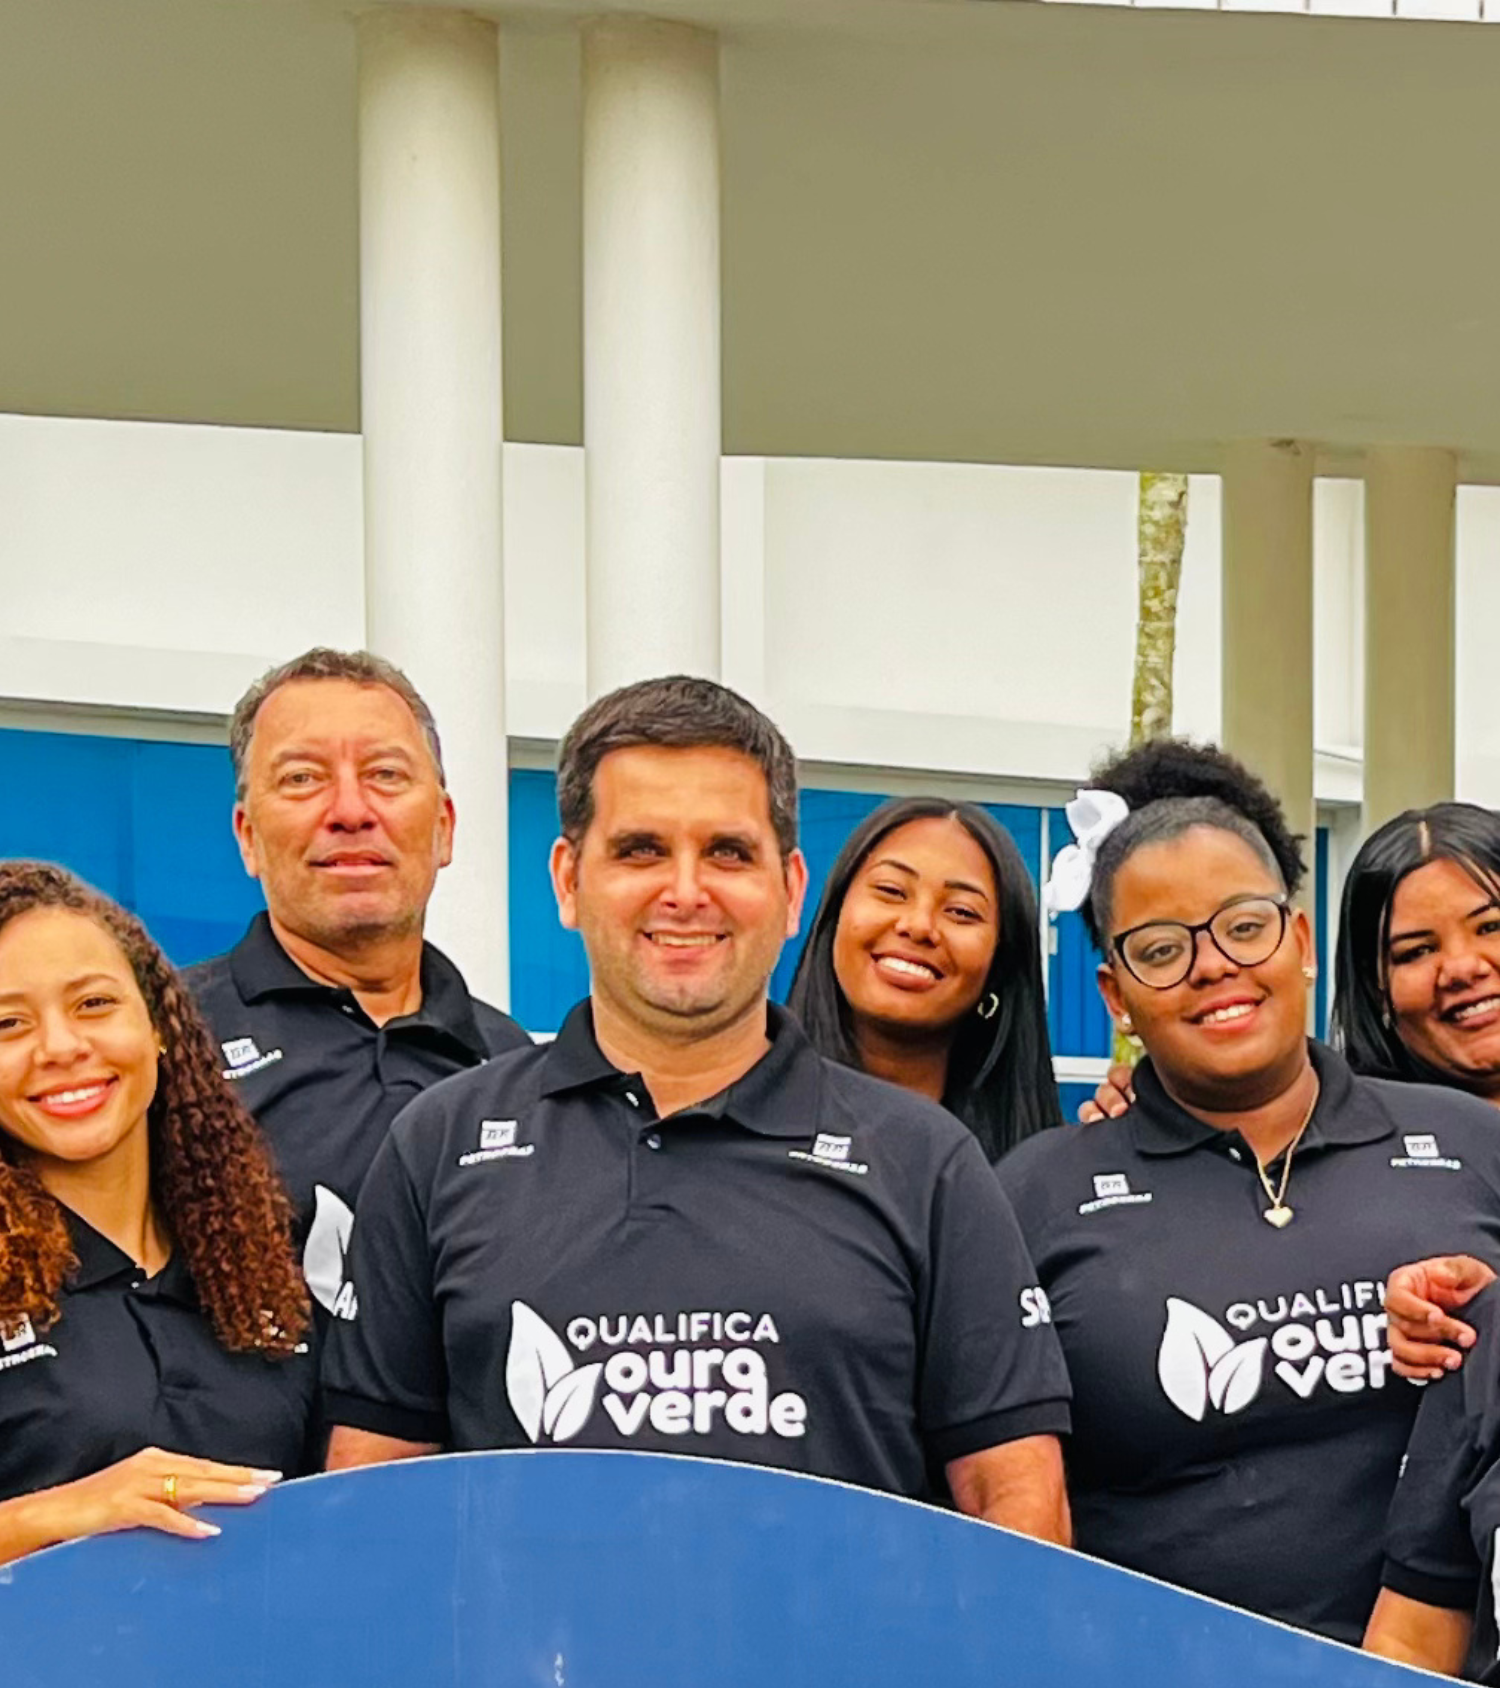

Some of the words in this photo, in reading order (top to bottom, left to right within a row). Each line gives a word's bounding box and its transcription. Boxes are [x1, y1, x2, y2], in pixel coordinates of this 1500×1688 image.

[565, 1311, 780, 1350] QUALIFICA
[1224, 1280, 1387, 1332] QUALIFI
[1270, 1312, 1389, 1361] our
[1272, 1347, 1395, 1400] ver
[601, 1388, 809, 1438] verde
